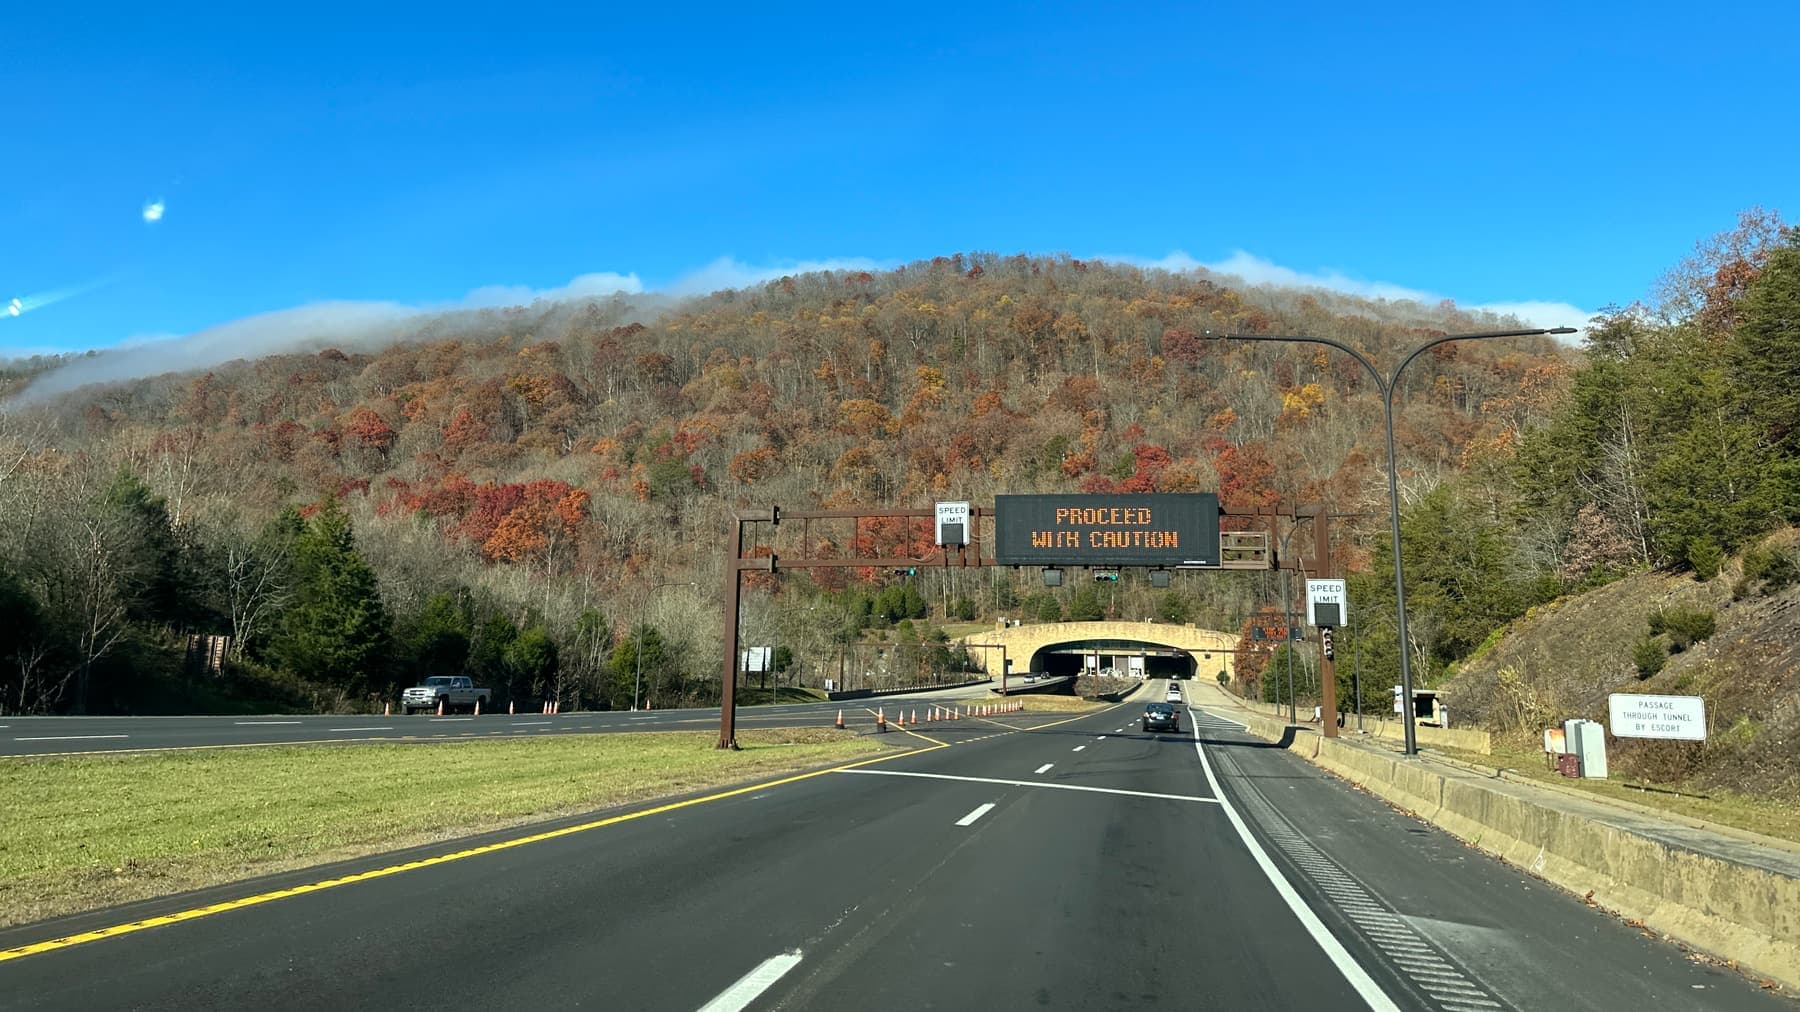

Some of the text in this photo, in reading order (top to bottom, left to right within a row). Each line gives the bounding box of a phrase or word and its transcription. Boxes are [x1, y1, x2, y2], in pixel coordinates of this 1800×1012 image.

[1056, 507, 1151, 525] PROCEED
[1031, 531, 1178, 548] WITH CAUTION
[1310, 584, 1342, 592] SPEED
[1314, 595, 1339, 603] LIMIT
[1638, 701, 1674, 710] PASSAGE
[1623, 711, 1692, 722] THROUGH TUNNEL
[1635, 723, 1680, 732] BY ESCORT
